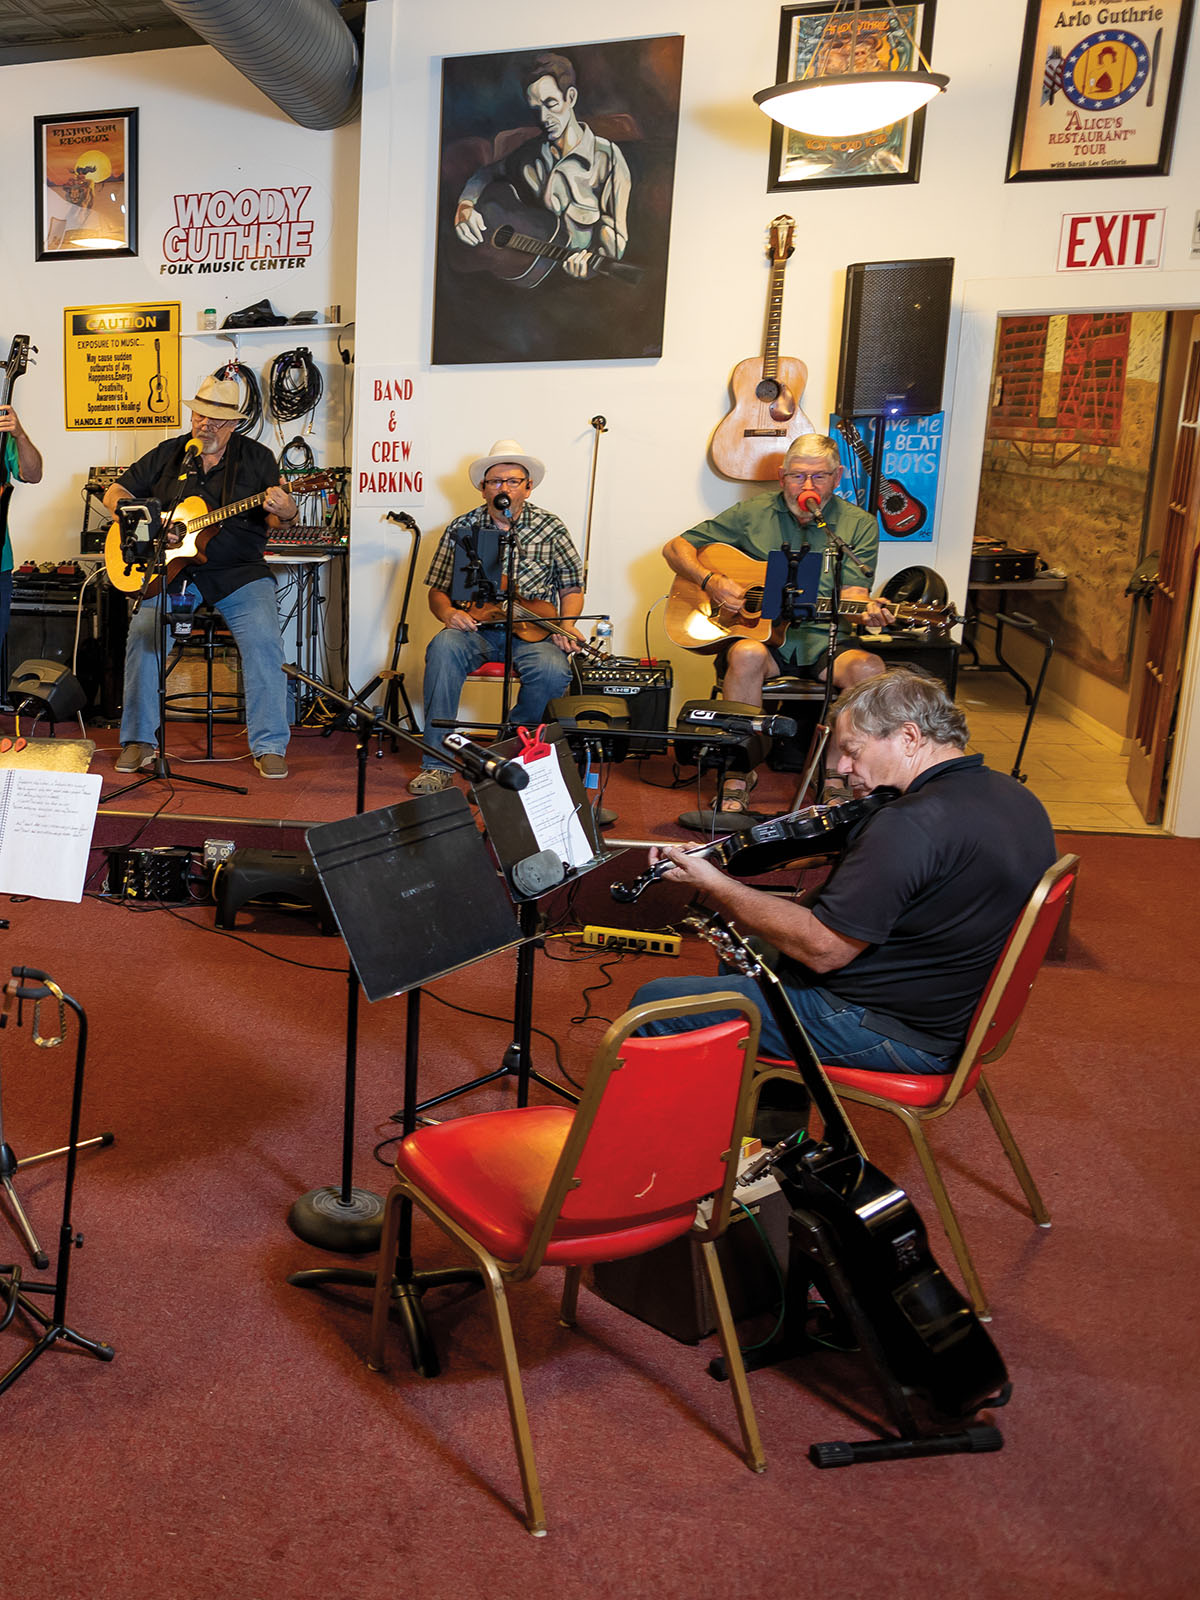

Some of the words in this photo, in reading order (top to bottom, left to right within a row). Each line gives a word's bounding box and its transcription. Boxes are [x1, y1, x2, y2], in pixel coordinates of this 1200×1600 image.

[1054, 10, 1091, 28] Arlo
[1097, 4, 1163, 25] Guthrie
[59, 133, 110, 145] RECORDS
[1073, 144, 1107, 156] TOUR
[1068, 160, 1087, 168] Sarah
[1088, 159, 1099, 167] Lee
[1101, 158, 1127, 166] Guthrie
[173, 185, 312, 229] WOODY
[163, 220, 314, 263] GUTHRIE
[1066, 212, 1157, 268] EXIT
[160, 263, 195, 275] FOLK
[197, 260, 245, 274] MUSIC
[250, 257, 306, 271] CENTER
[86, 315, 157, 331] CAUTION
[77, 340, 109, 349] EXPOSURE
[111, 339, 119, 348] TO
[86, 353, 97, 364] May
[98, 354, 113, 362] cause
[114, 352, 132, 361] sudden
[90, 363, 114, 372] outbursts
[115, 363, 120, 371] of
[96, 393, 123, 401] Awareness
[373, 378, 414, 401] BAND
[87, 403, 120, 413] Spontaneous
[74, 417, 103, 426] HANDLE
[104, 417, 113, 425] AT
[116, 417, 135, 425] YOUR
[136, 416, 153, 424] OWN
[154, 415, 175, 423] RISK!
[388, 409, 397, 433] &
[917, 417, 941, 433] Me
[895, 434, 943, 452] BEAT
[371, 441, 413, 463] CREW
[884, 452, 937, 475] BOYS
[359, 471, 423, 493] PARKING
